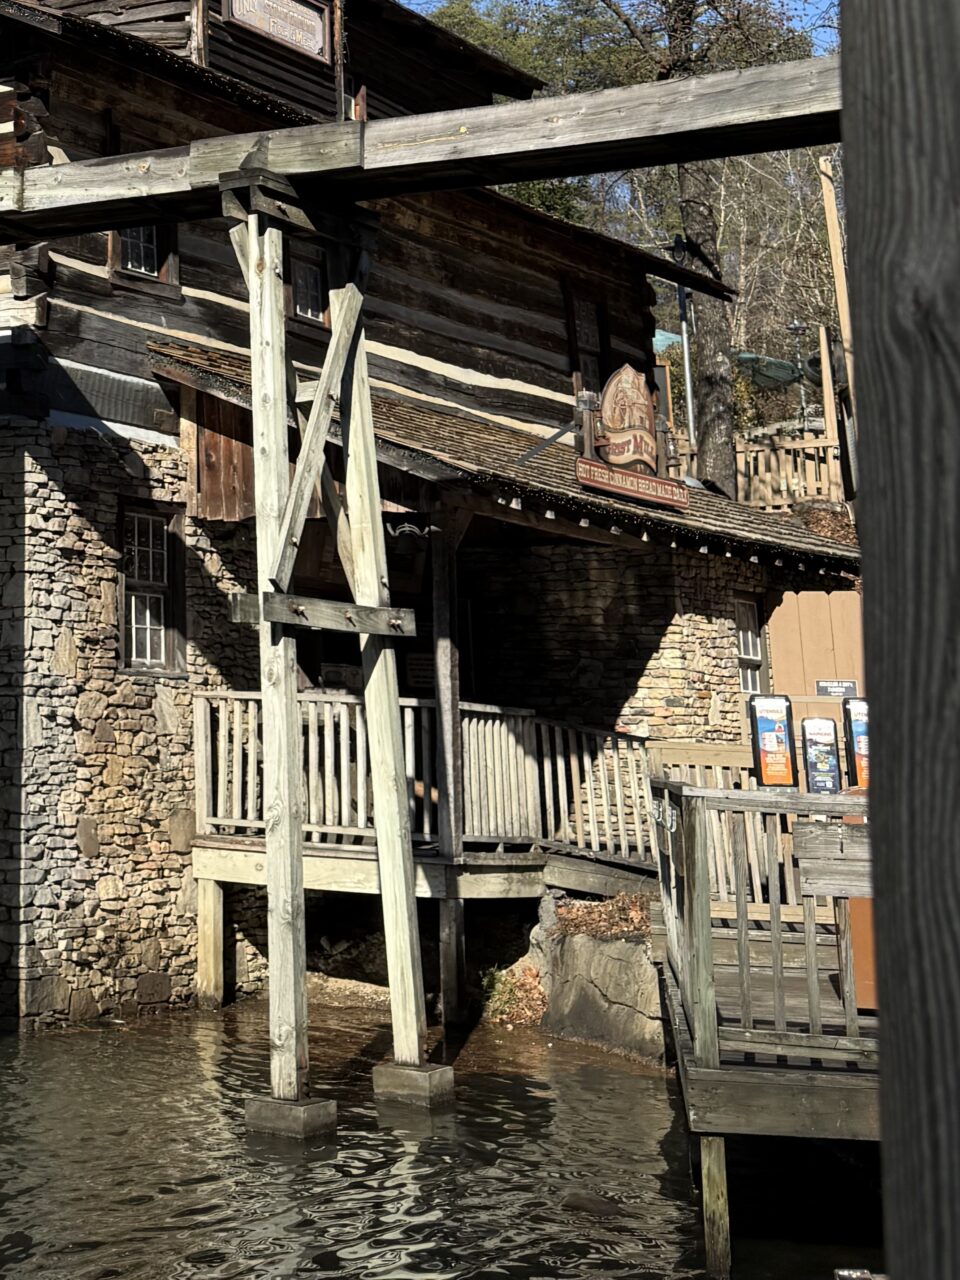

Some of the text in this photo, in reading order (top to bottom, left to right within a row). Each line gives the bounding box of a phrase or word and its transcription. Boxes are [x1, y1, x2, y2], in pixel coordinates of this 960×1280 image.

[578, 463, 590, 478] HOT
[590, 465, 609, 484] FRESH
[609, 471, 638, 492] CINNAMON
[638, 479, 657, 495] BREAD
